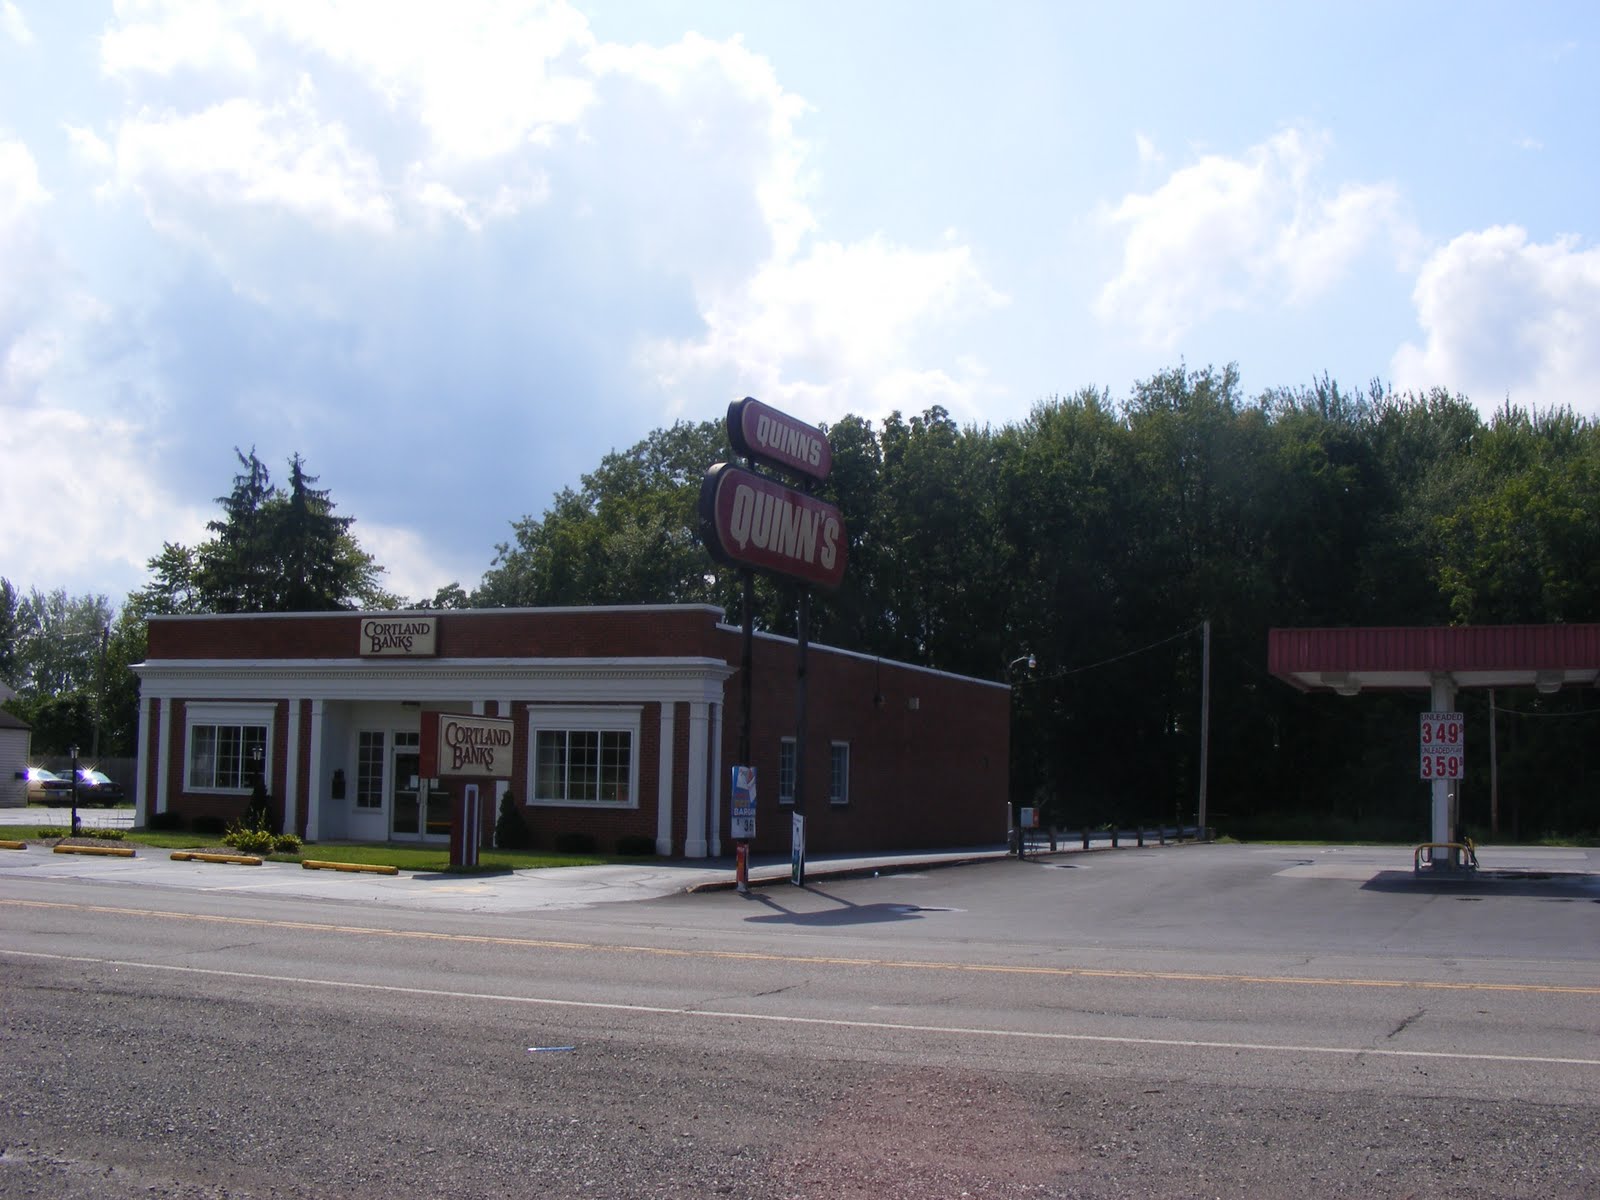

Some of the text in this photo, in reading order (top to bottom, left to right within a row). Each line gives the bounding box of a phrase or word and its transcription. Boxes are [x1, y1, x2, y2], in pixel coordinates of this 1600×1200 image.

[730, 484, 840, 570] QUINN'S
[364, 621, 430, 640] CORTLAND
[370, 636, 413, 653] BANKS
[1422, 713, 1463, 721] UNLEADED
[446, 721, 511, 748] CORTLAND
[451, 744, 495, 771] BANKS
